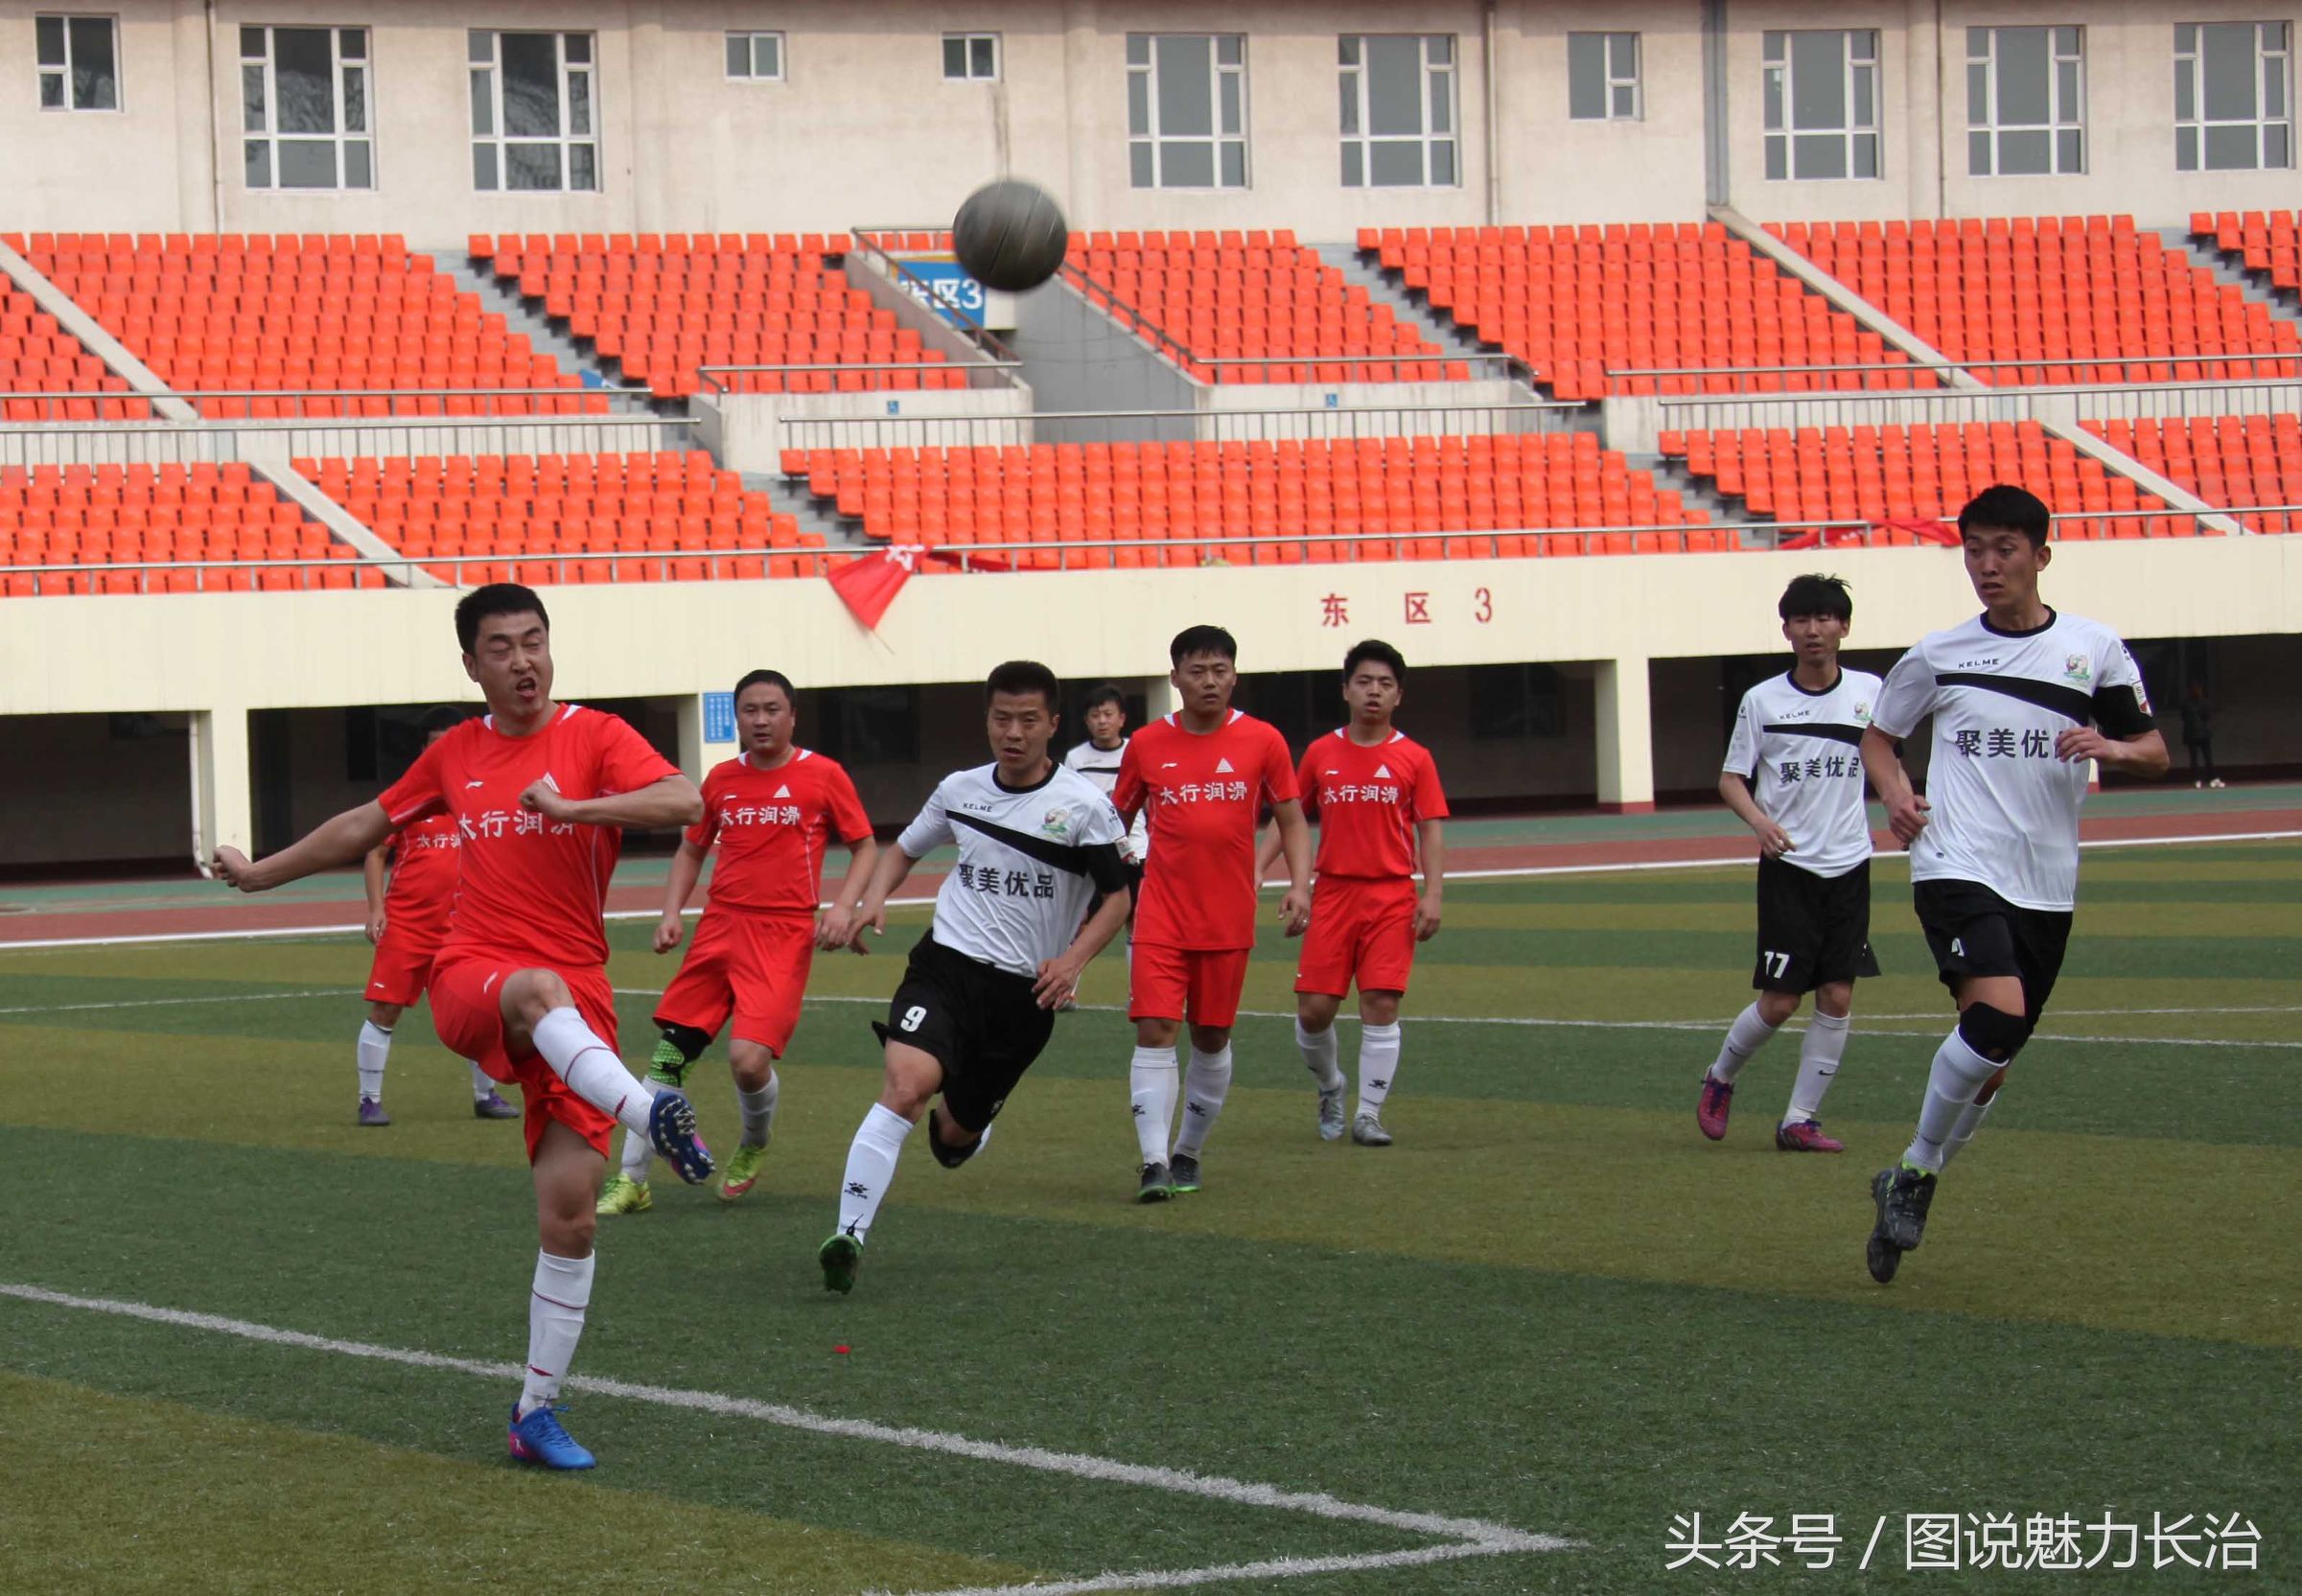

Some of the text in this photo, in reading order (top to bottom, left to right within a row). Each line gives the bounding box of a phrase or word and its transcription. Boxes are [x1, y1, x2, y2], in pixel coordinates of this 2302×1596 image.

[1958, 659, 2000, 669] KELME
[1779, 709, 1811, 720] KELME
[1955, 728, 2066, 759] 聚美优
[1160, 781, 1247, 806] 太行润滑
[1324, 784, 1399, 805] 太行润滑
[963, 801, 993, 813] KELME
[959, 864, 1055, 899] 聚美优品
[900, 1006, 927, 1032] 9
